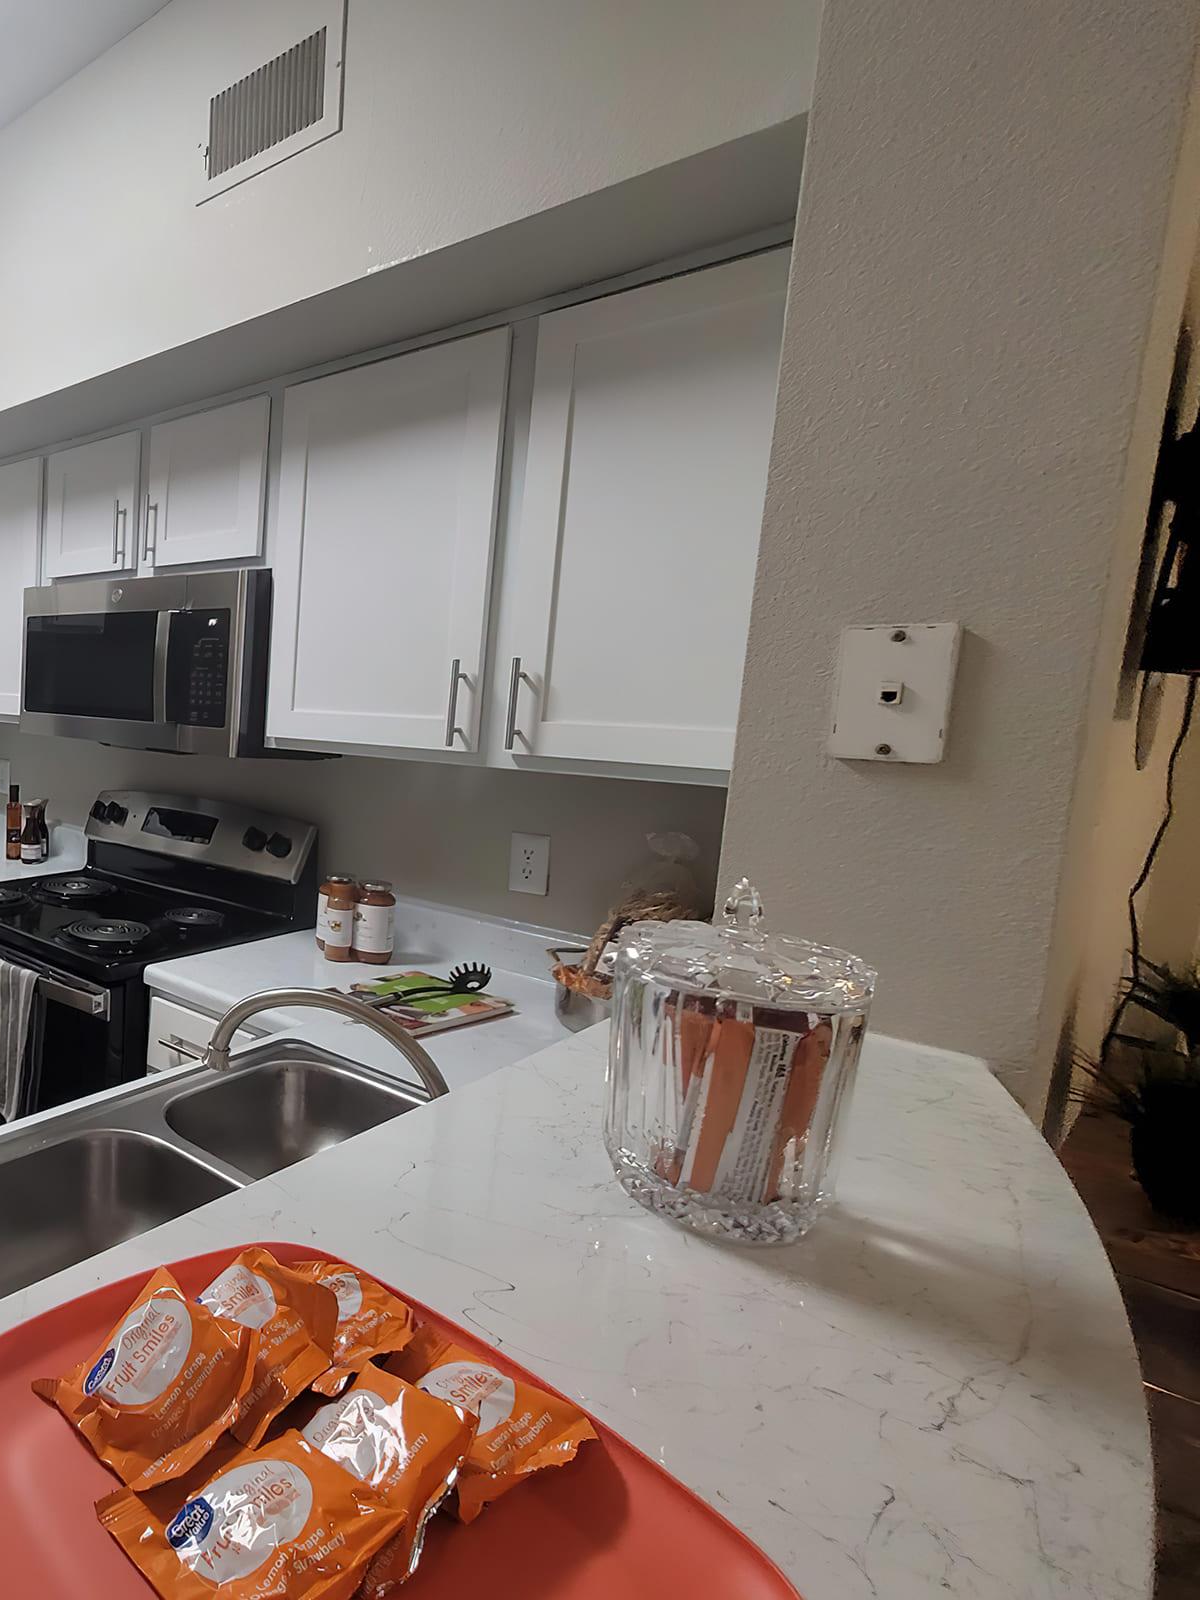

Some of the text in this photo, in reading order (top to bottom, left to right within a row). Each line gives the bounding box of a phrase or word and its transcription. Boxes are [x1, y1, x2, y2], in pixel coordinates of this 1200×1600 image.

[122, 1306, 161, 1351] Original
[105, 1313, 176, 1395] Fruit Smiles
[154, 1386, 182, 1420] Lemon
[171, 1504, 206, 1539] Great
[184, 1511, 210, 1541] Value
[255, 1551, 290, 1591] Lemon
